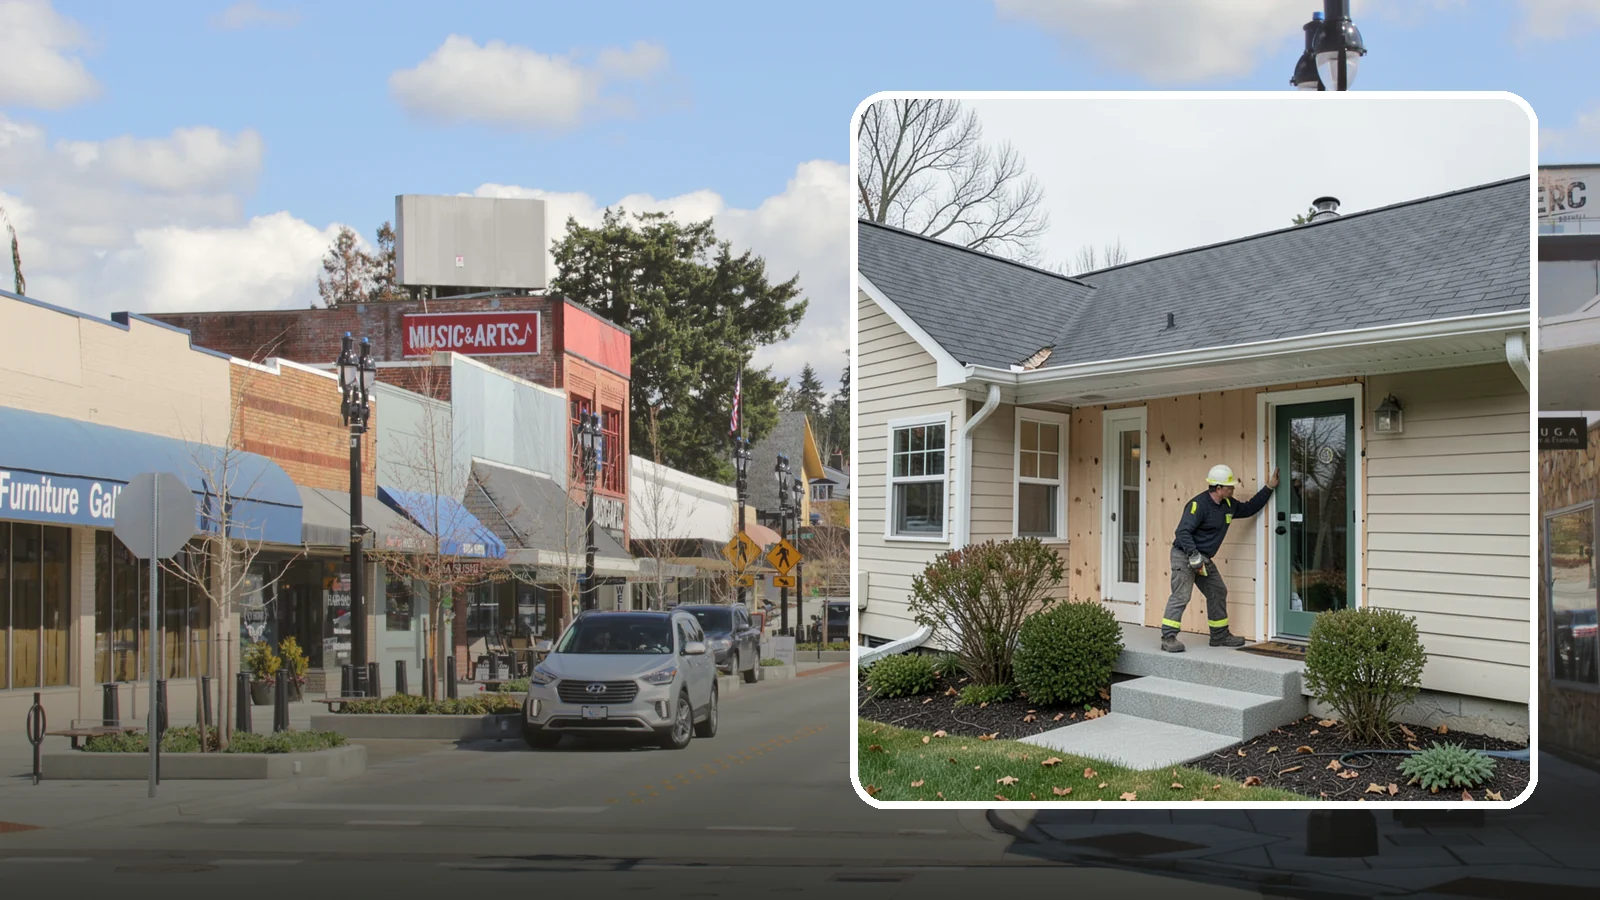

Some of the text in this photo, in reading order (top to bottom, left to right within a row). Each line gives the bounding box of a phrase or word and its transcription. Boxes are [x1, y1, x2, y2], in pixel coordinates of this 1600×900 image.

[0, 471, 122, 519] Furniture Gal
[453, 563, 479, 574] SUSHI
